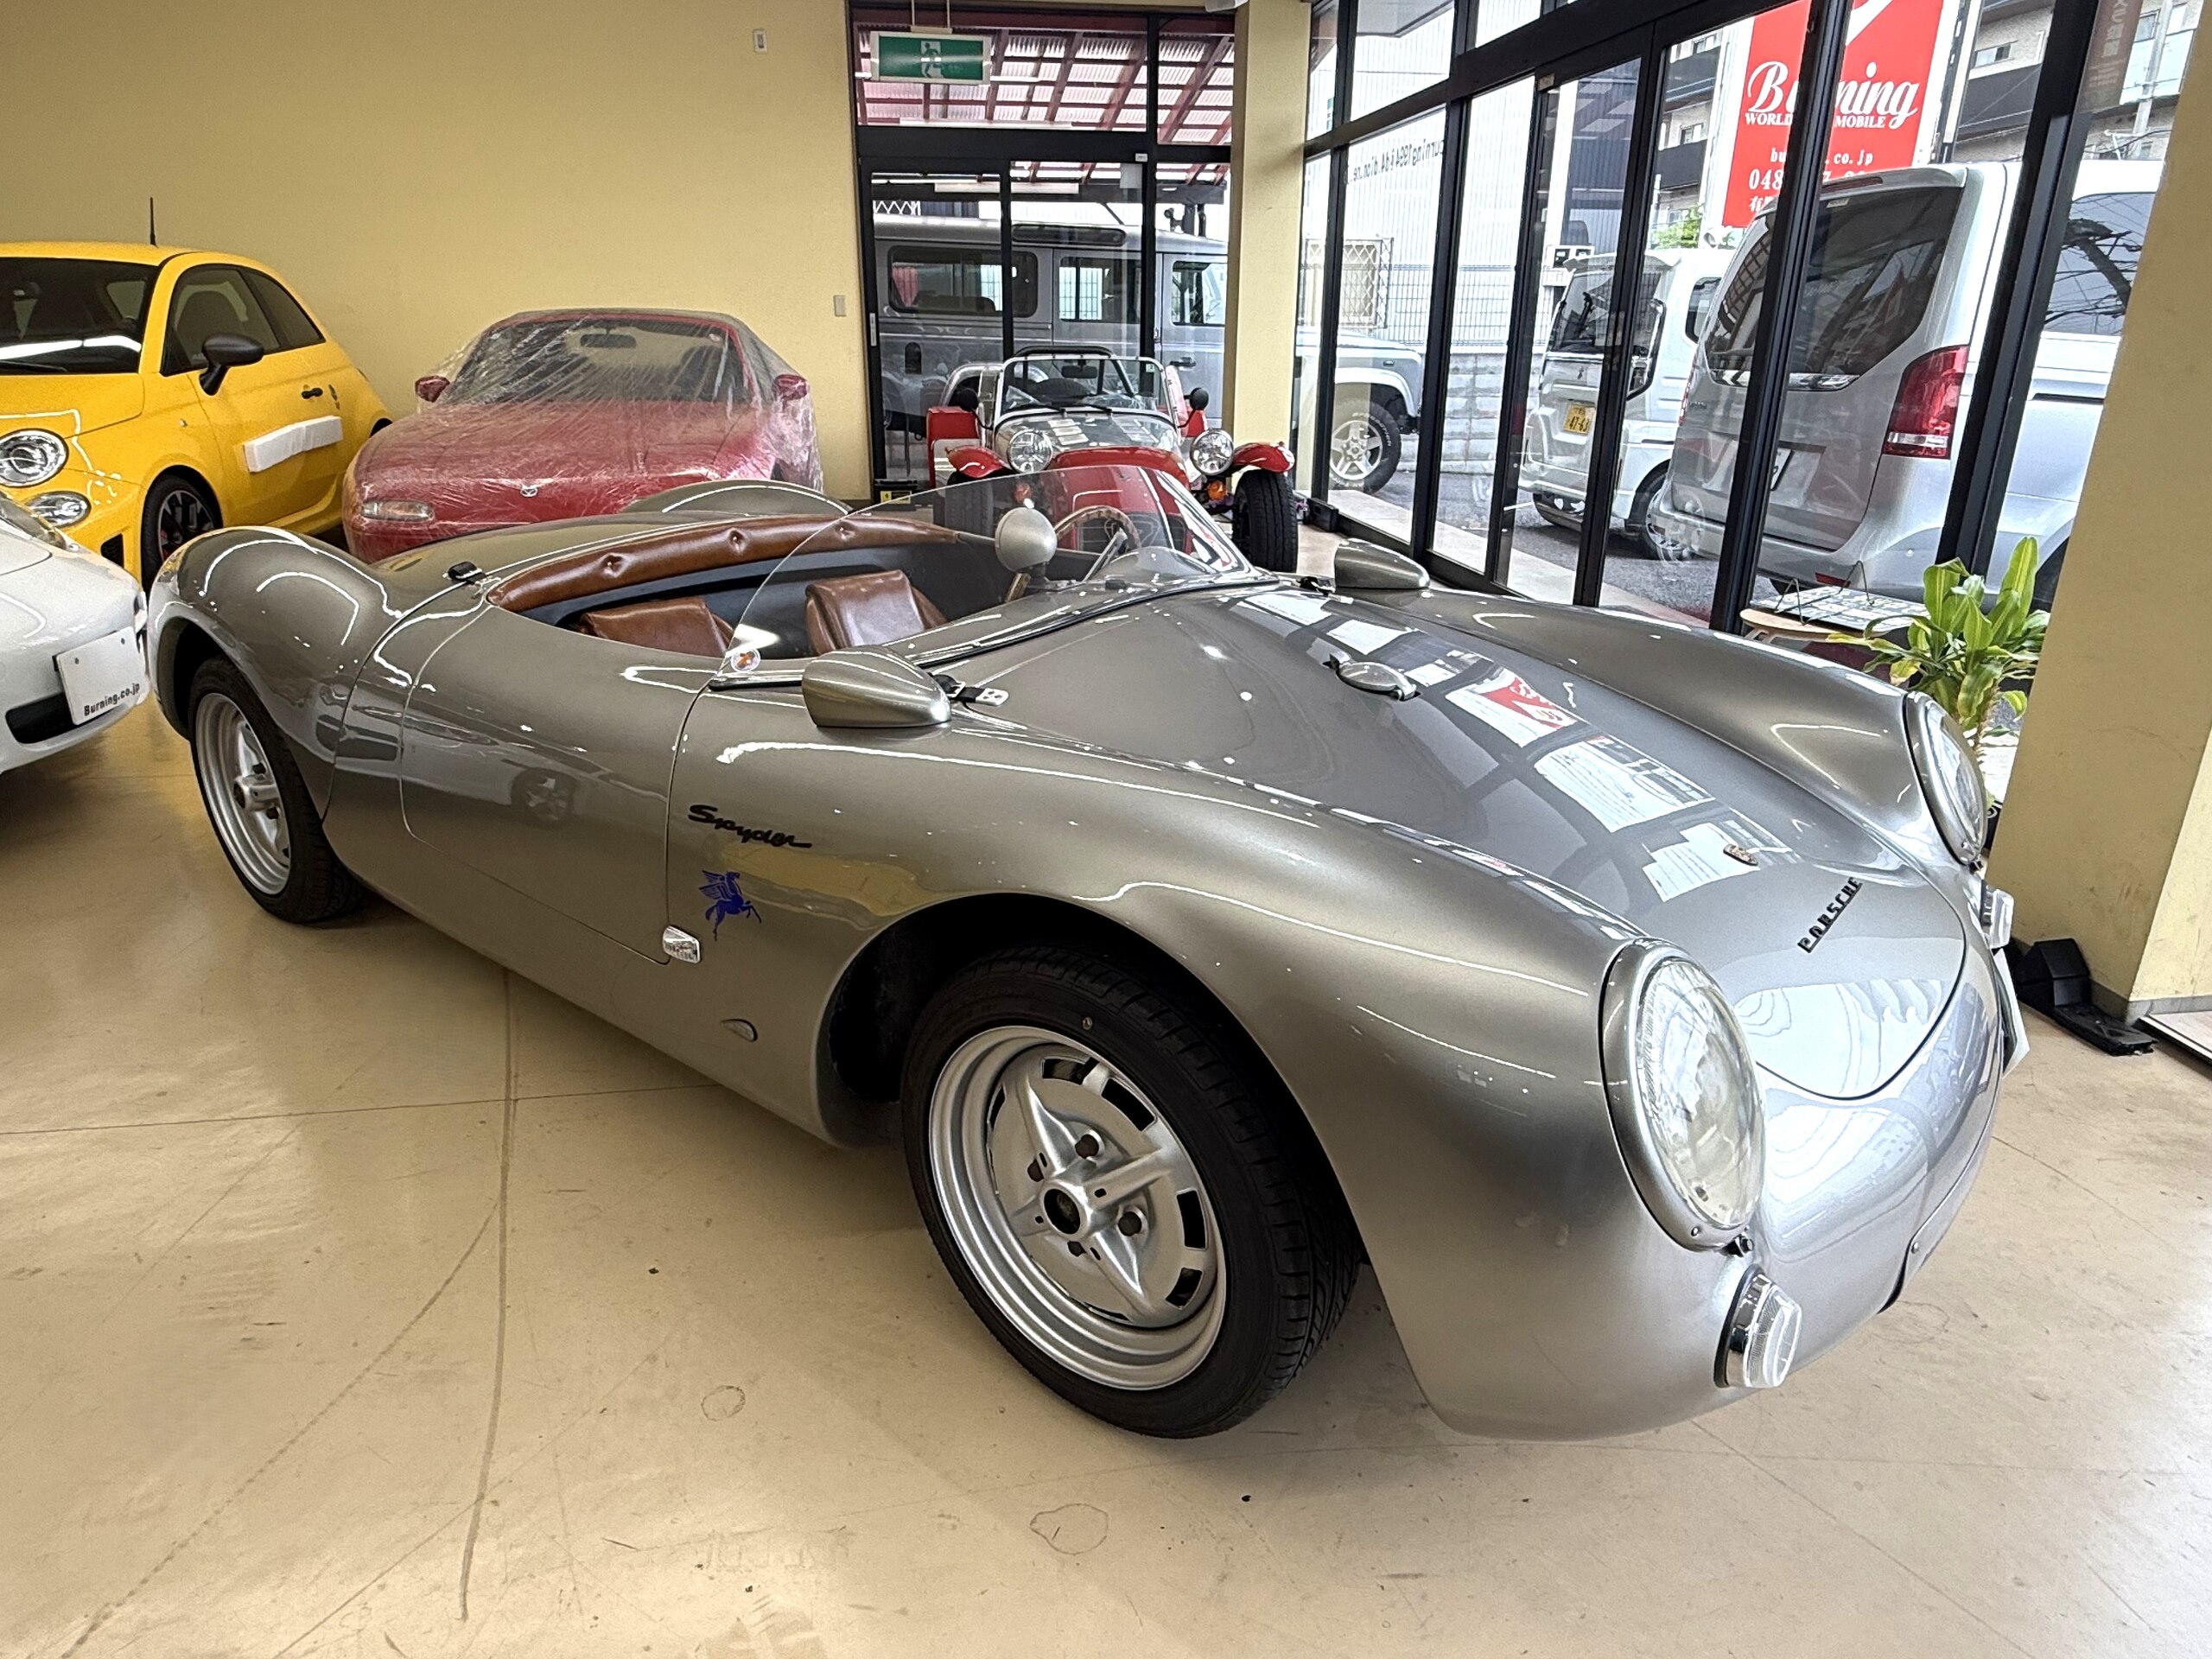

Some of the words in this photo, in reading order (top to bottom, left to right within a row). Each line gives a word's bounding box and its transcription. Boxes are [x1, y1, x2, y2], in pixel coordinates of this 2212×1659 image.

[1747, 60, 1920, 130] Bning
[83, 682, 141, 716] Burning.co.jp
[687, 804, 813, 849] Spyder
[1796, 876, 1864, 954] PORSCHE
